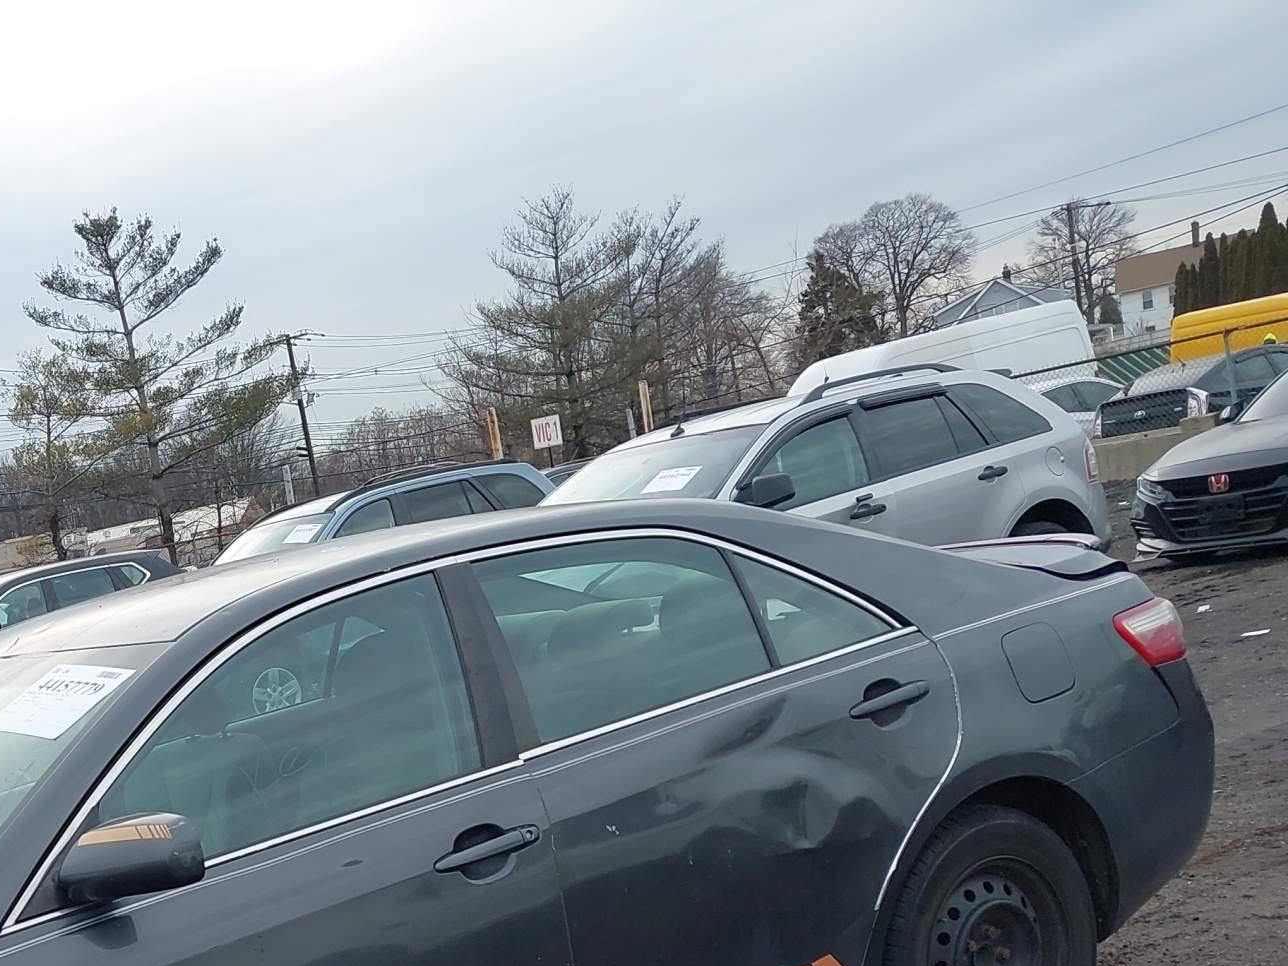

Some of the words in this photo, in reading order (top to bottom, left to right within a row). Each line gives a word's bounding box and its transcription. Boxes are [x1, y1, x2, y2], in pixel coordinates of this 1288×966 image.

[534, 421, 552, 443] VIC
[553, 420, 559, 441] 1
[38, 679, 106, 695] 44157779
